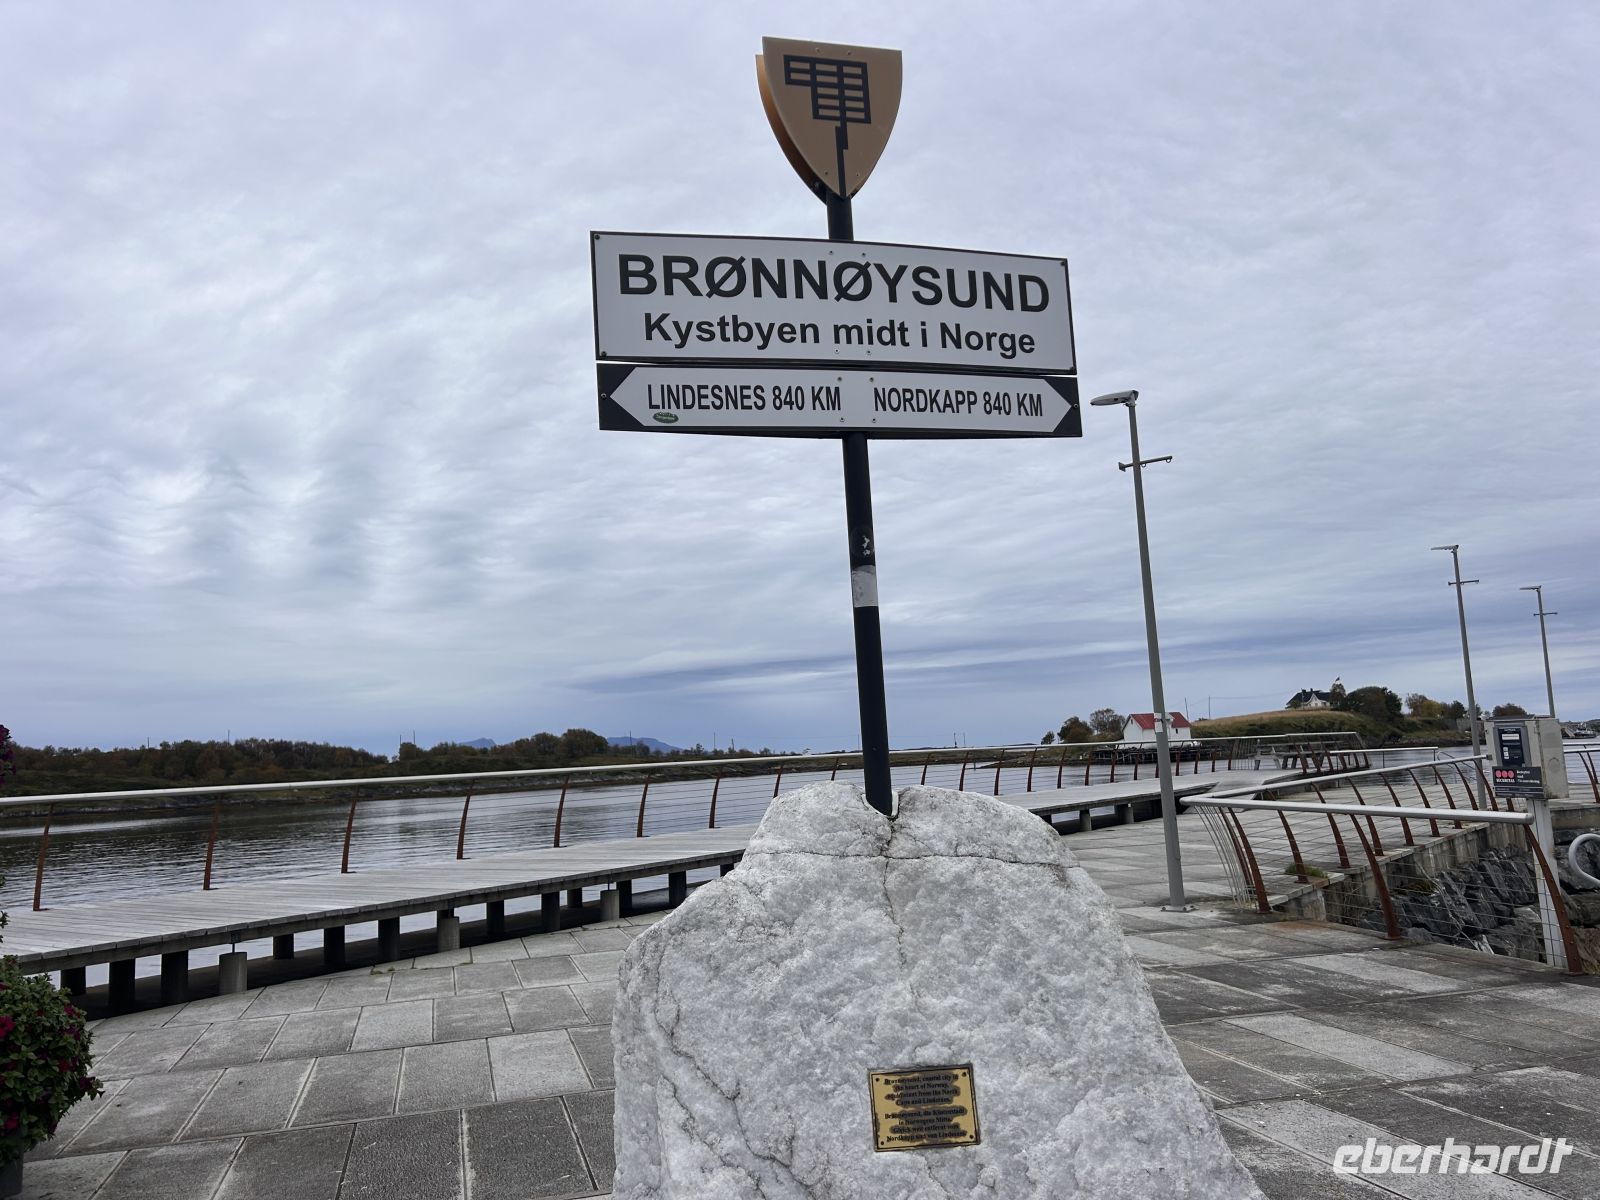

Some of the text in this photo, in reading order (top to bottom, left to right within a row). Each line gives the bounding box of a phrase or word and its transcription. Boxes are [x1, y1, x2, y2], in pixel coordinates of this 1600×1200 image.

[618, 253, 1050, 312] BRØNNØYSUND
[644, 312, 1035, 359] Kystbyen midt i Norge
[648, 384, 841, 411] LINDESNES 840 KM
[874, 387, 1043, 417] NORDKAPP 840 KM
